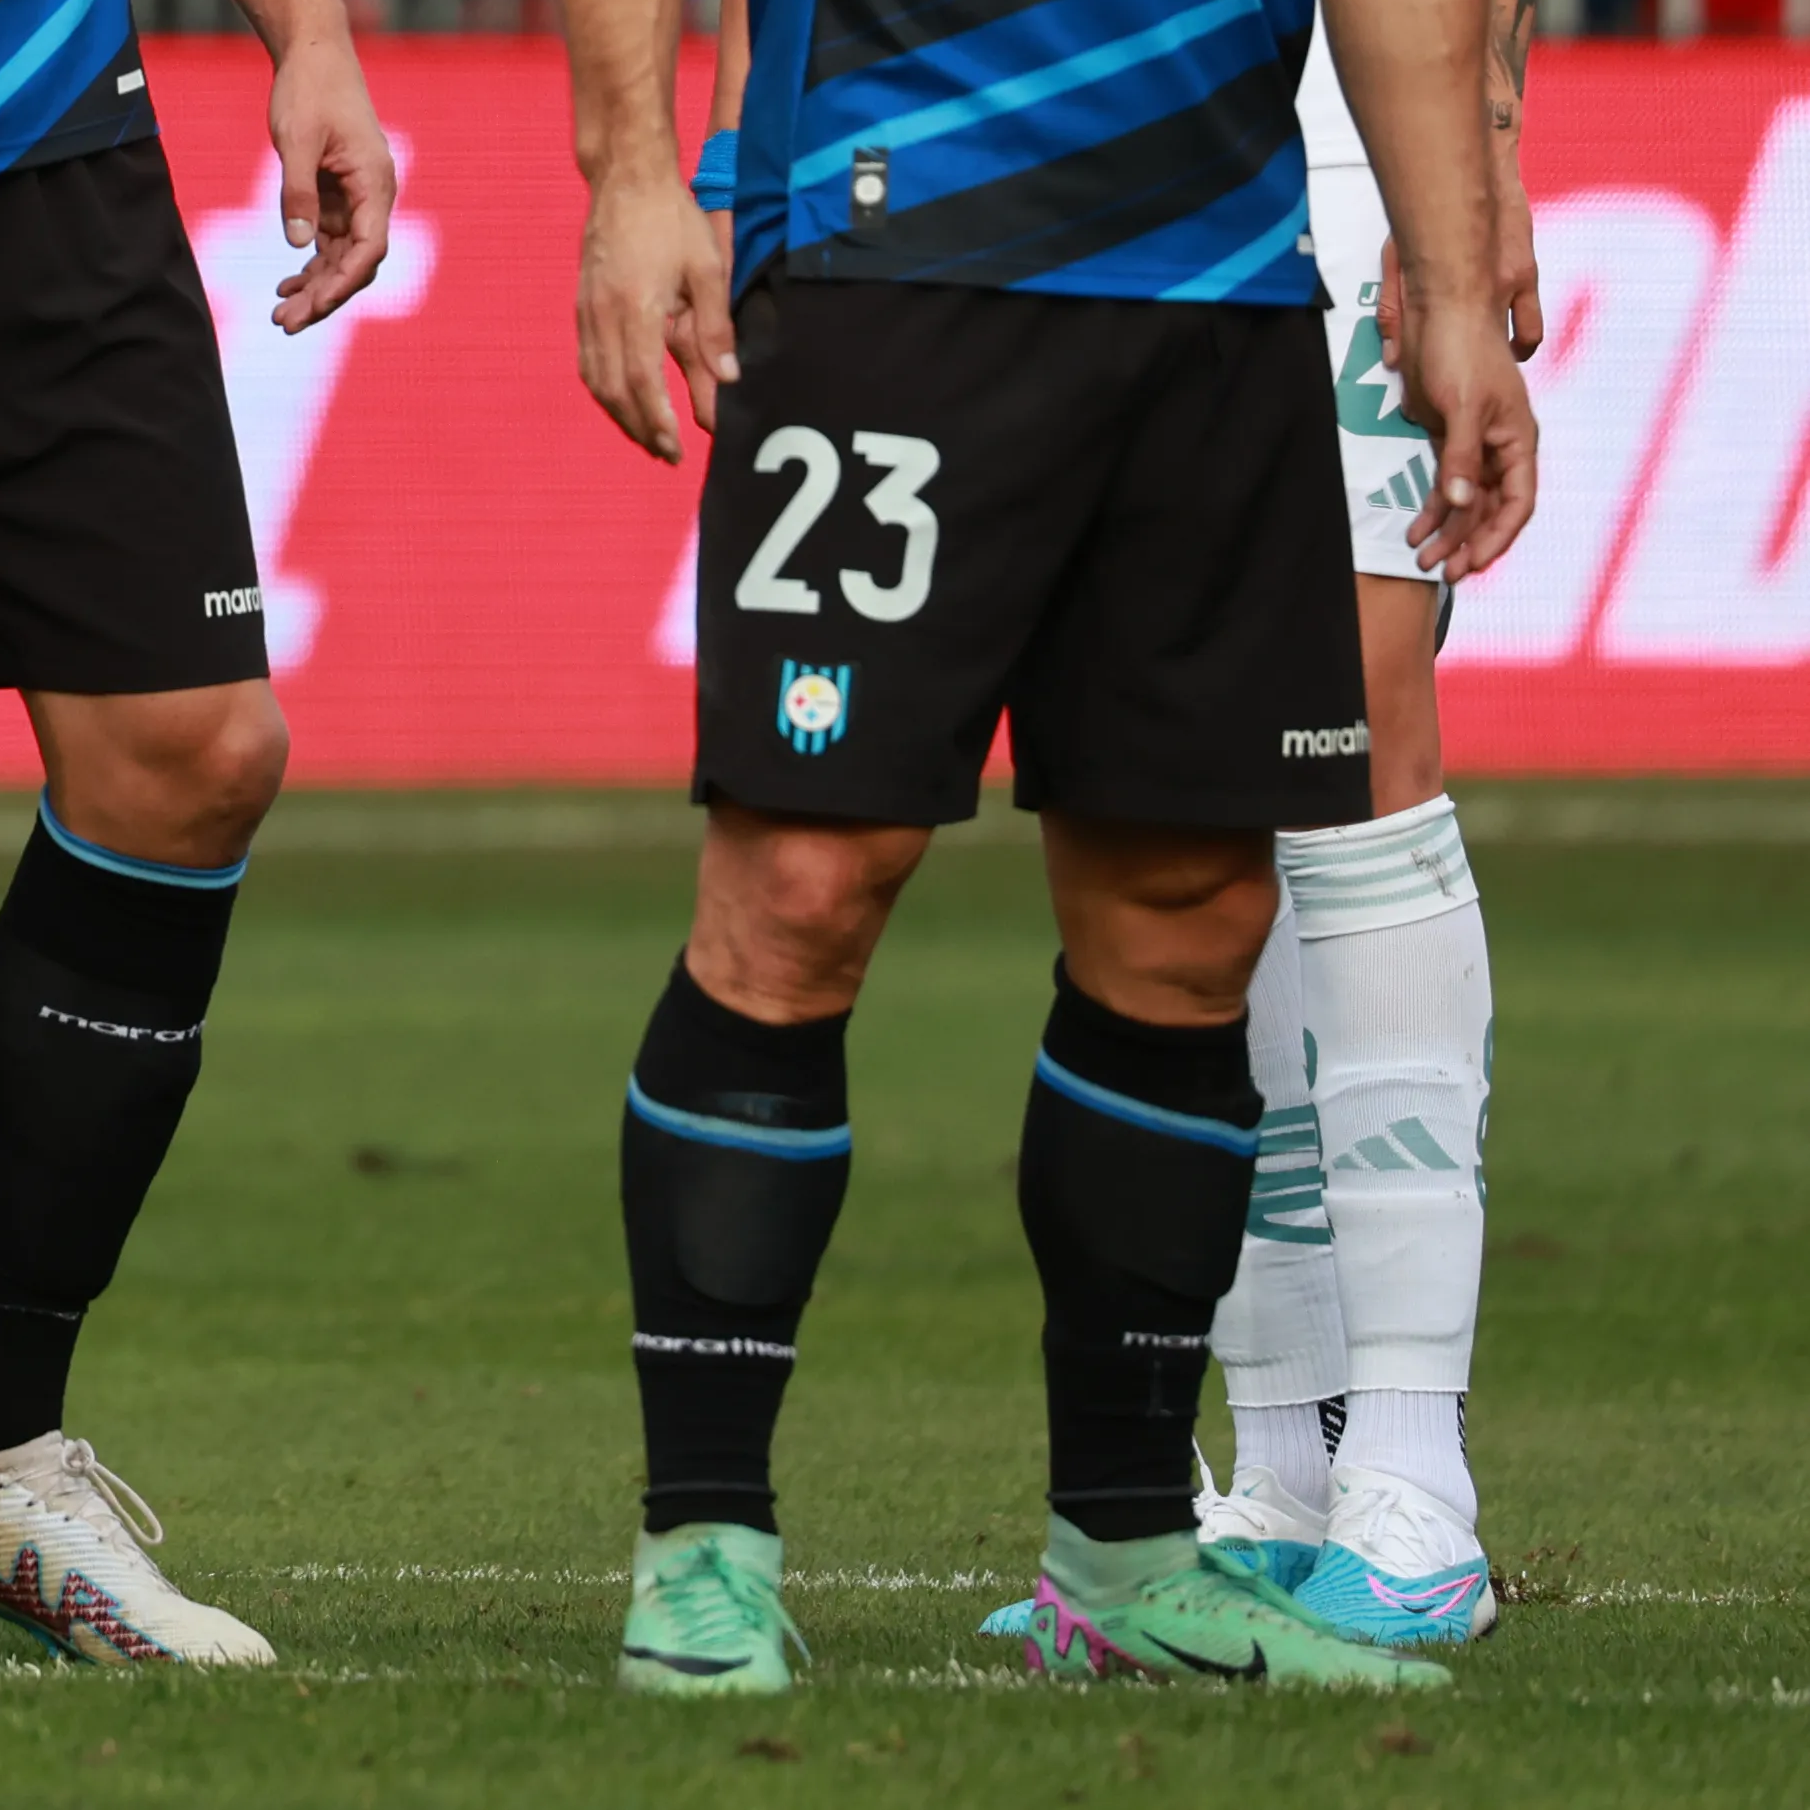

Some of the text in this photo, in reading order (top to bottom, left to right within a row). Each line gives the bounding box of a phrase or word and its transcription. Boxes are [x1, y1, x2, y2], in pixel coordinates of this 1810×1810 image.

[735, 426, 940, 622] 23
[1282, 720, 1371, 758] marath
[632, 1332, 798, 1359] marathon
